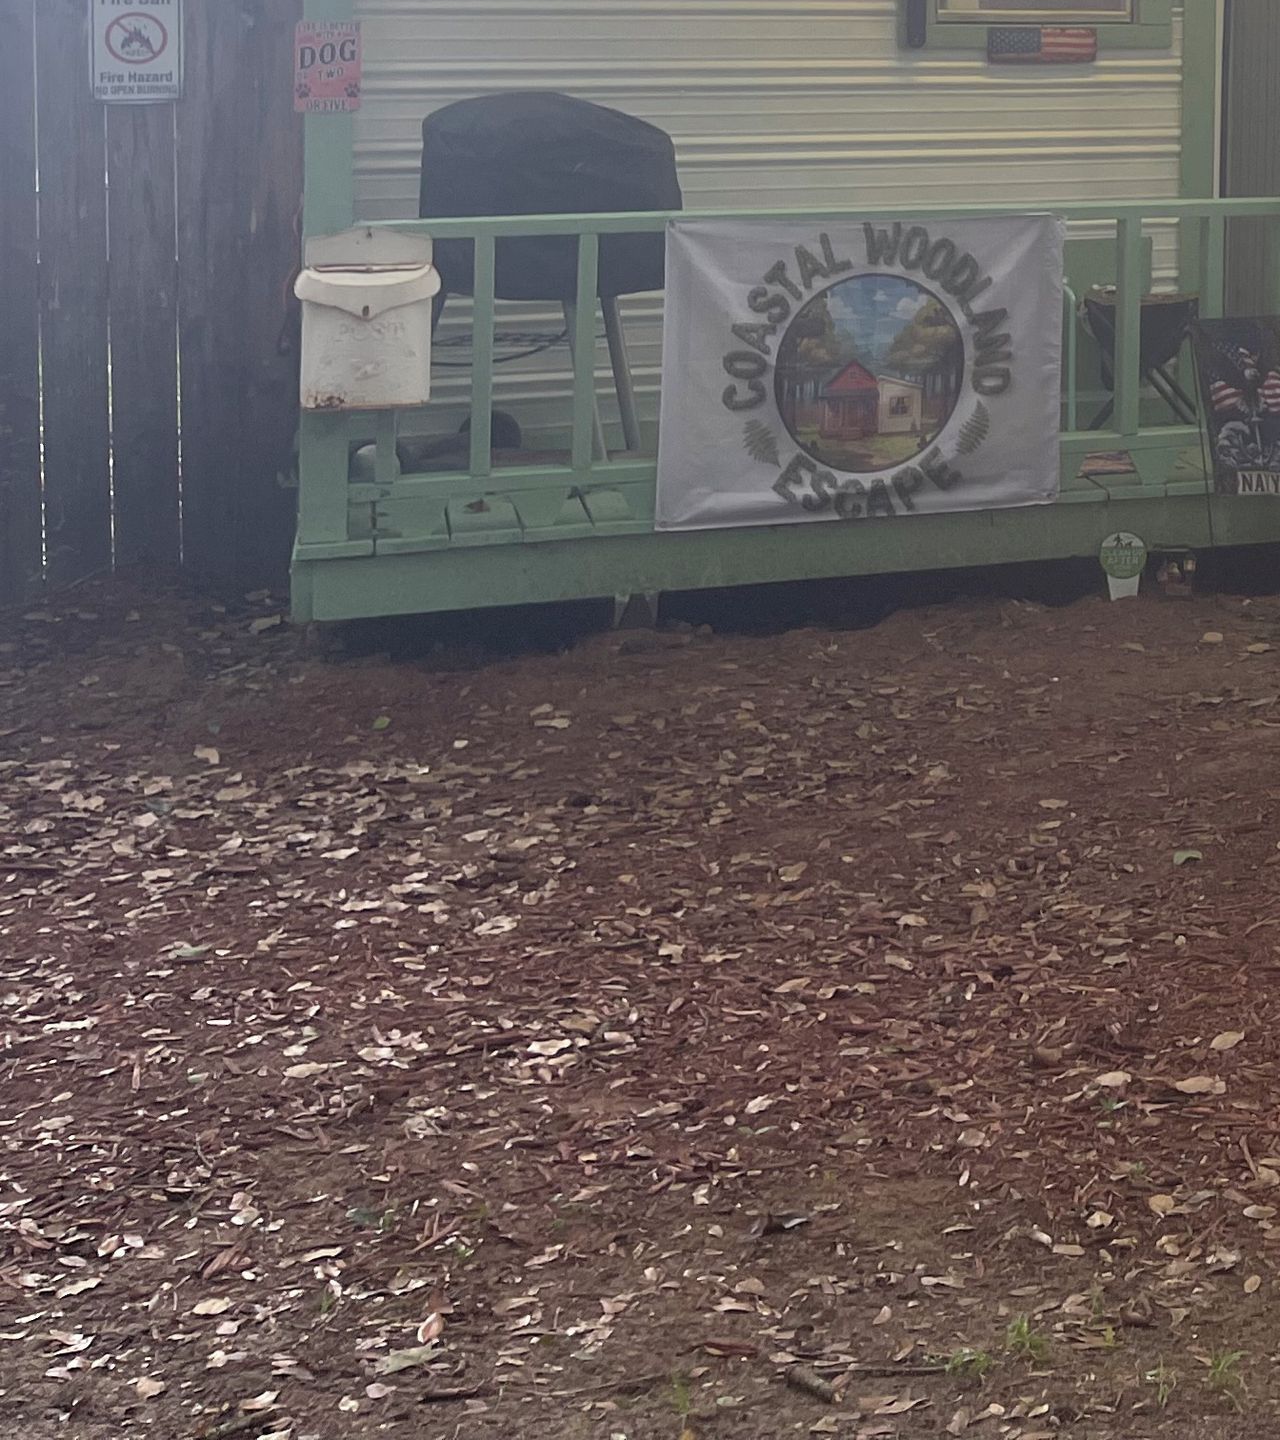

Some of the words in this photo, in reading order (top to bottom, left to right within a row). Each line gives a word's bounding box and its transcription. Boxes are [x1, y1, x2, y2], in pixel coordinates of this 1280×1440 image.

[299, 38, 357, 70] DOG
[100, 71, 125, 83] Fire
[129, 70, 173, 83] Hazard
[318, 67, 344, 80] TWO
[722, 232, 853, 412] COASTAL
[862, 221, 1013, 397] WOODLAND
[771, 445, 962, 519] ESCAPE
